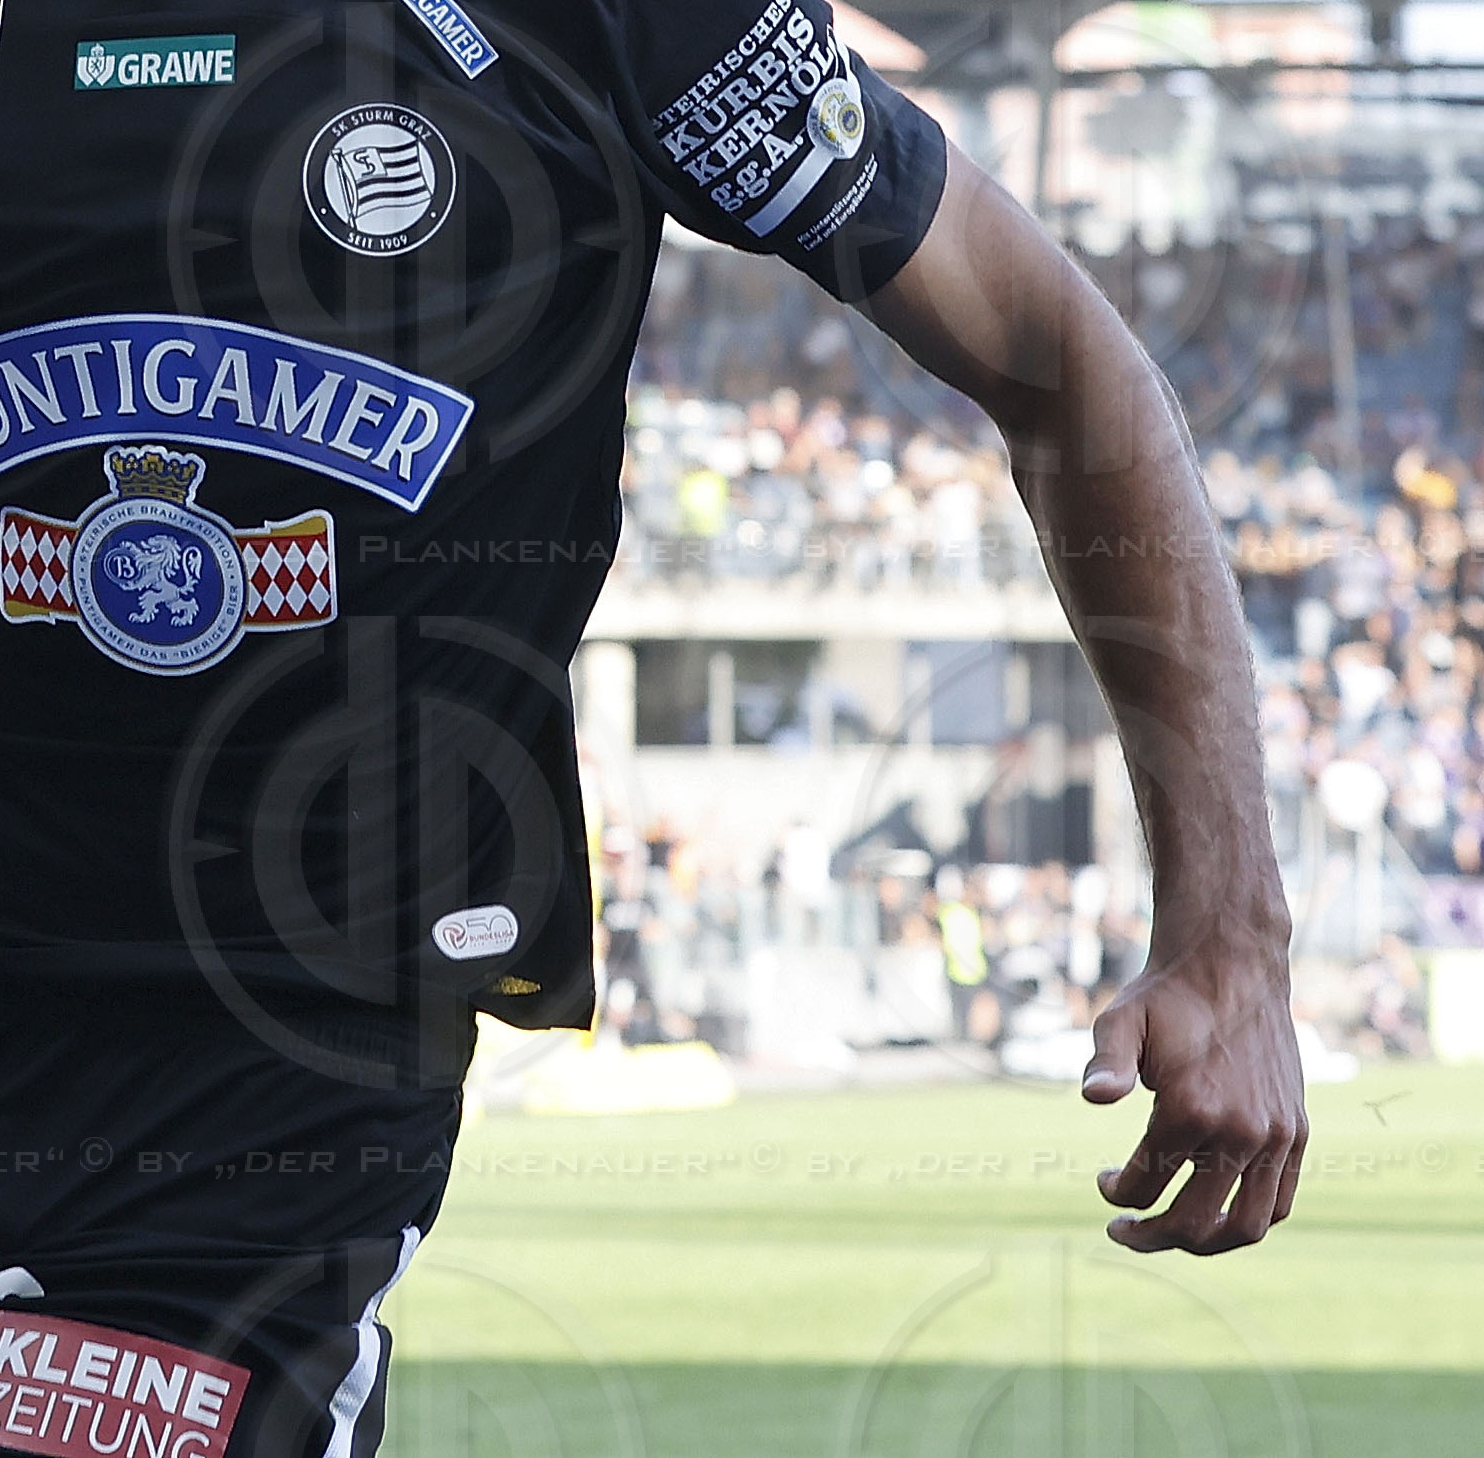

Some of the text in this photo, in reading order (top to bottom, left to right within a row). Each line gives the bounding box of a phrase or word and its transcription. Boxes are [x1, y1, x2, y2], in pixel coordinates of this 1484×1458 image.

[118, 48, 233, 84] GRAWE
[661, 7, 815, 163] KÜRBIS
[331, 110, 433, 142] SK STURM GRAZ
[683, 41, 839, 187] KERNÖL
[711, 132, 804, 213] g.g.A.
[347, 231, 408, 250] SEIT 1909
[80, 505, 236, 570] STEIRISCHE BRAUTRADITION
